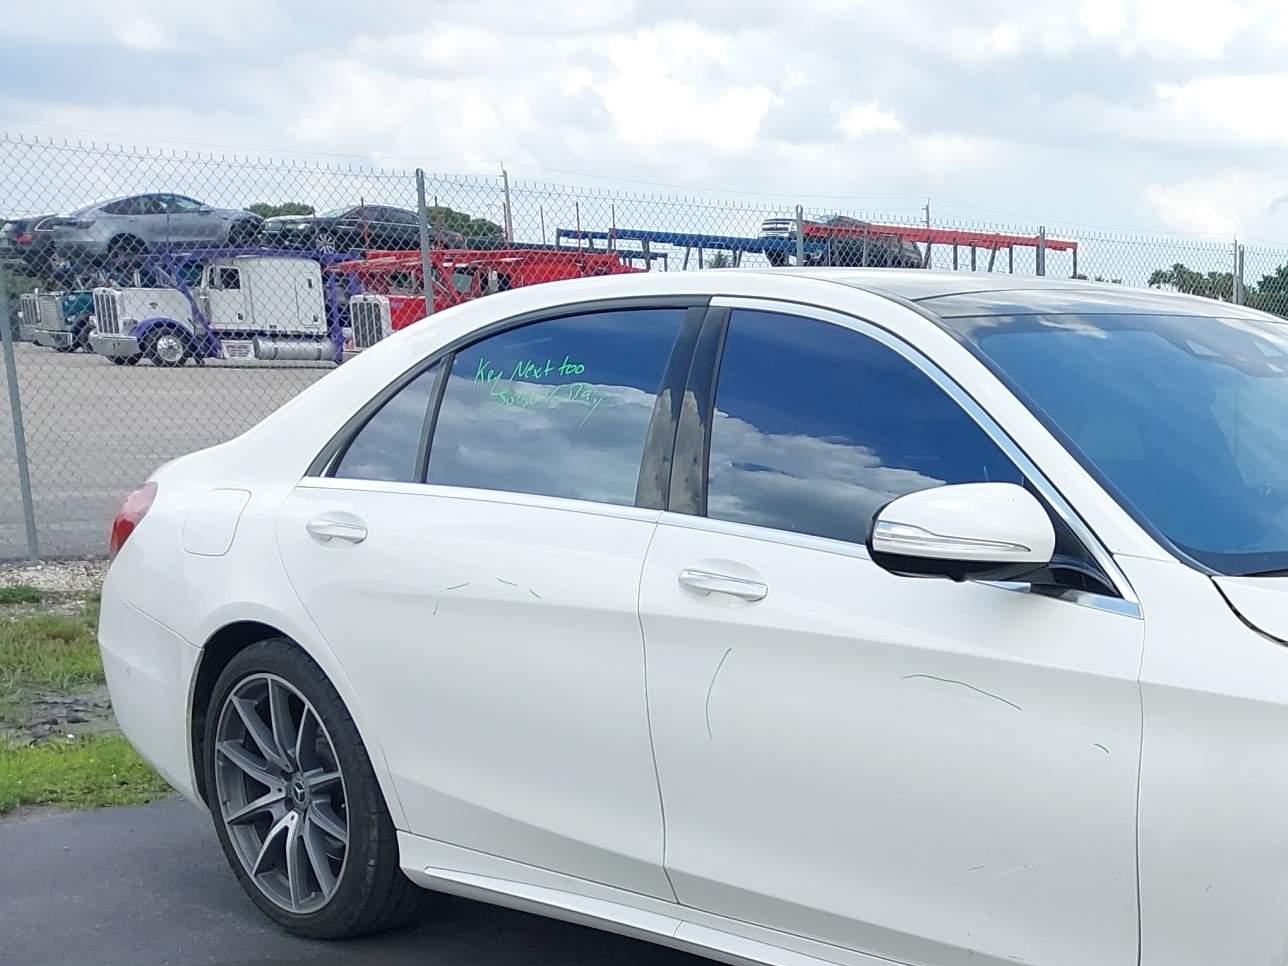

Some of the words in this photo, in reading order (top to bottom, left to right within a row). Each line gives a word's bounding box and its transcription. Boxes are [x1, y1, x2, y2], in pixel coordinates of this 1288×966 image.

[473, 357, 504, 395] Key
[508, 359, 553, 382] Next
[558, 355, 585, 376] too
